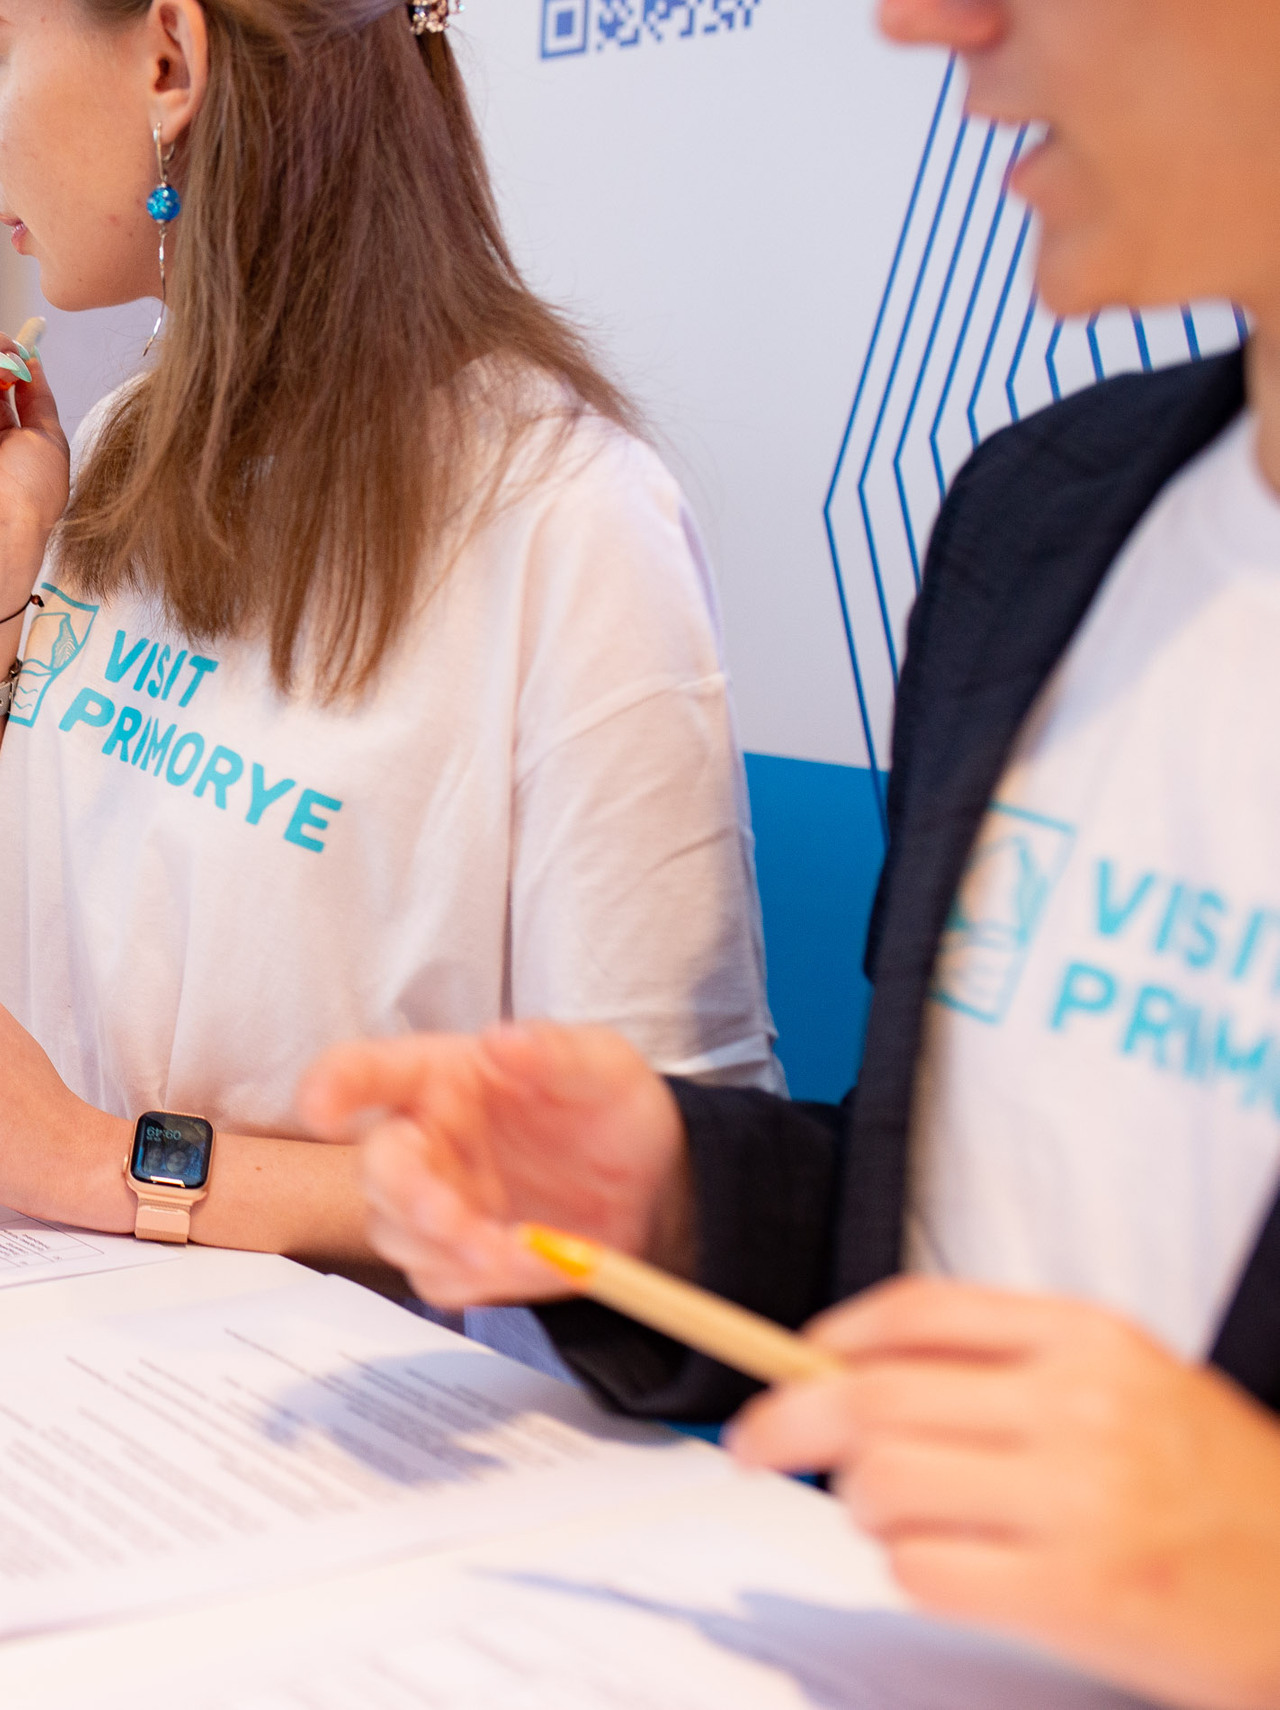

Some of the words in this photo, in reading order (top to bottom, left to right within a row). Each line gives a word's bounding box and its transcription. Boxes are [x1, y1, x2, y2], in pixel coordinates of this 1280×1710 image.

[104, 629, 219, 708] VISIT
[58, 687, 344, 854] PRIMORYE
[1048, 960, 1280, 1122] PRIM
